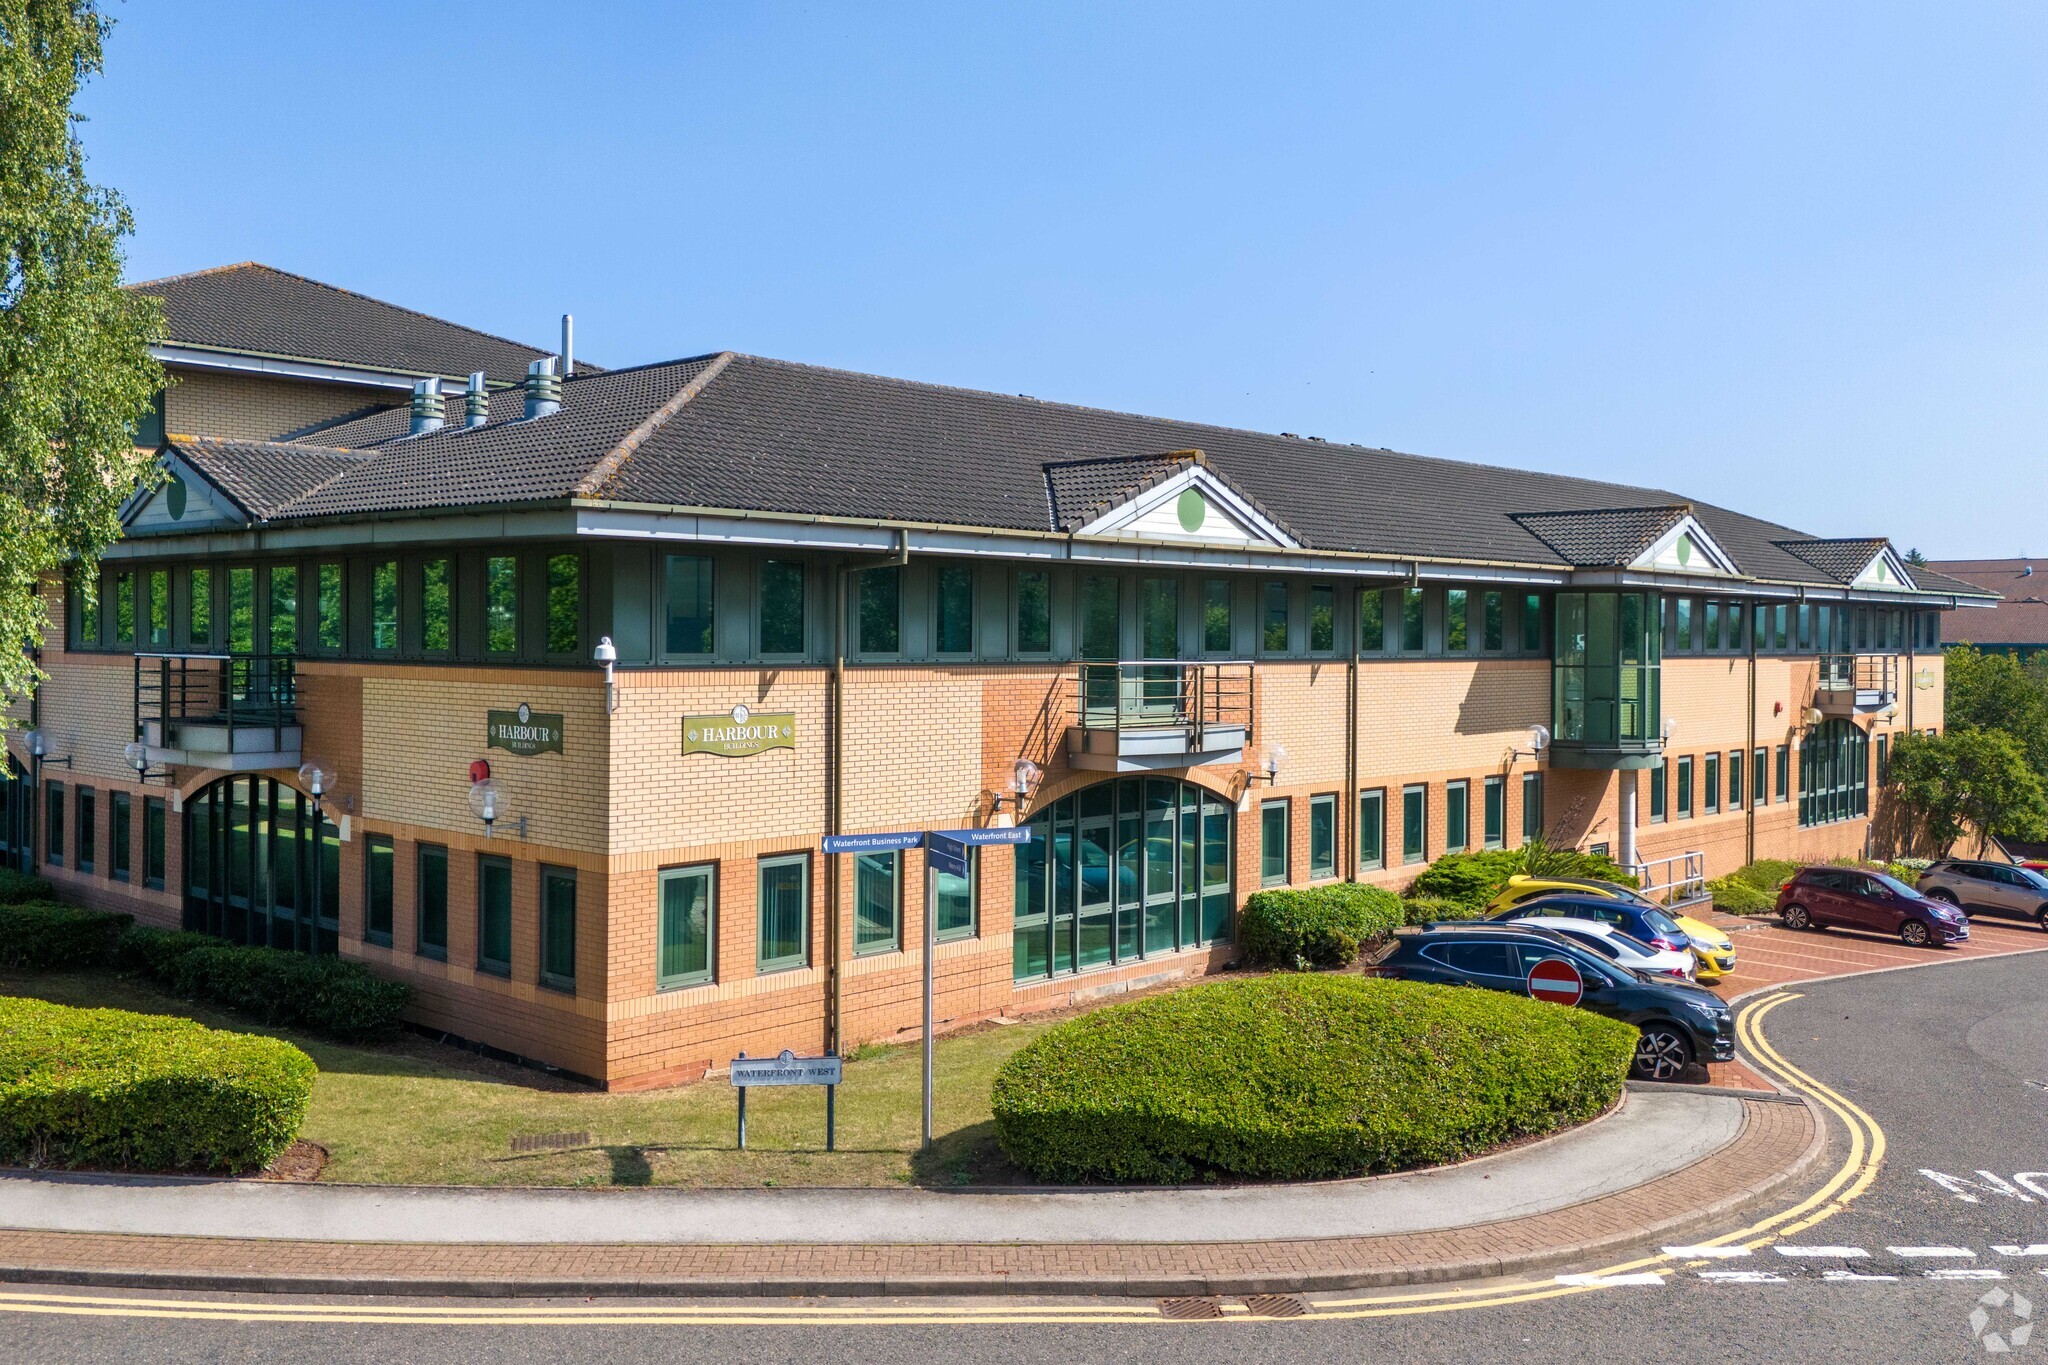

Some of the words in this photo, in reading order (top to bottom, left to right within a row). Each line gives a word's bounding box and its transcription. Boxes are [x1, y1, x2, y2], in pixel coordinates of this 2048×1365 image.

[499, 724, 549, 742] HARBOUR
[702, 725, 779, 742] HARBOUR
[511, 741, 537, 749] BUILDINGS
[723, 742, 759, 750] BUILDINGS
[832, 838, 871, 848] Waterfront
[872, 836, 902, 846] Business
[903, 835, 918, 844] Park
[971, 832, 1007, 841] Waterfront
[1007, 831, 1022, 840] East
[736, 1068, 804, 1078] WATERFRONT
[808, 1067, 836, 1076] WEST
